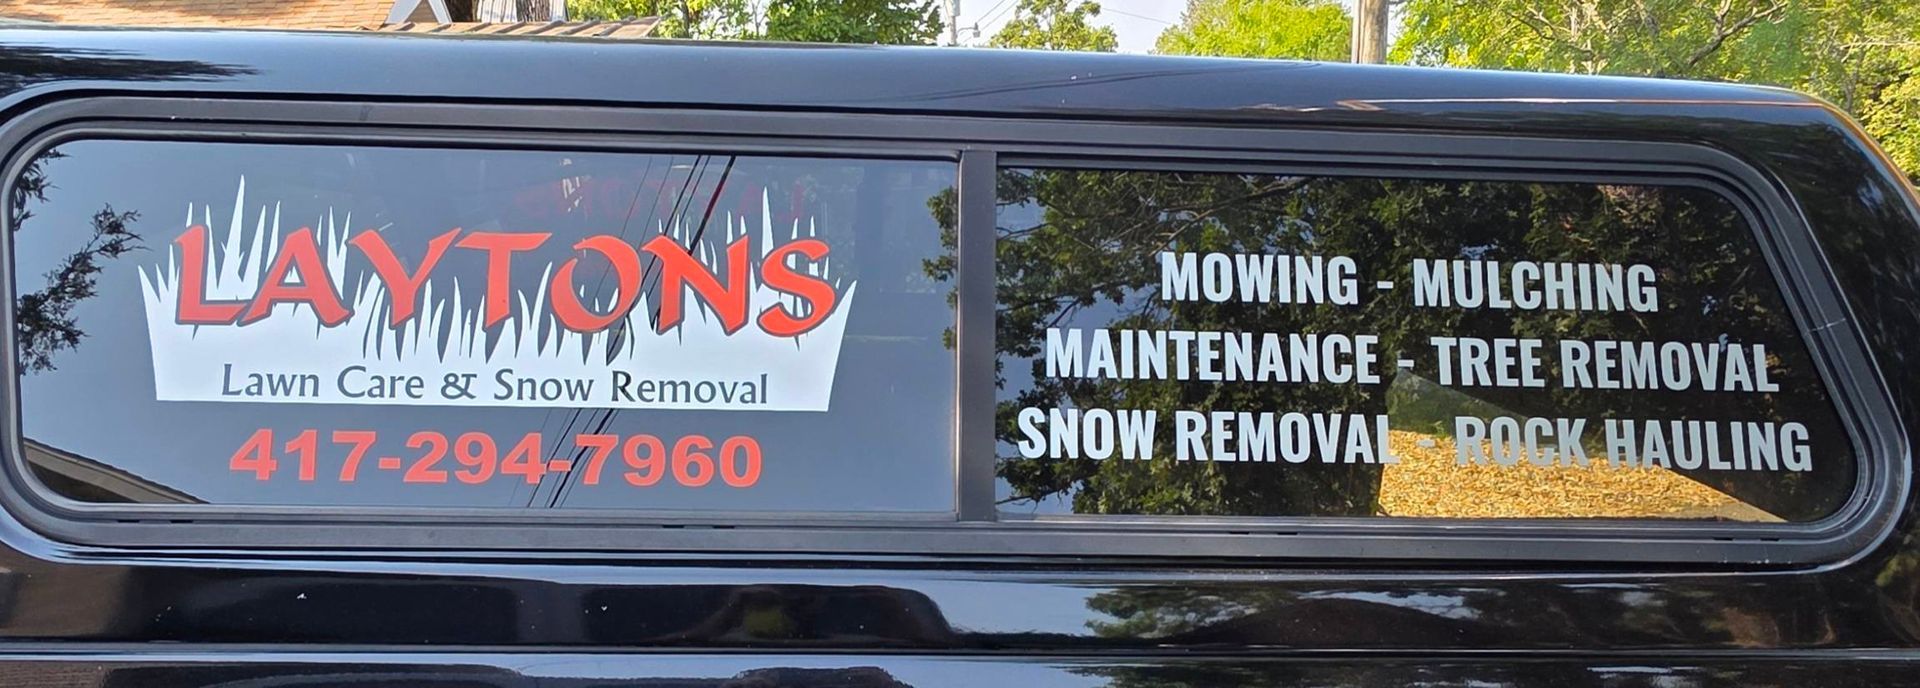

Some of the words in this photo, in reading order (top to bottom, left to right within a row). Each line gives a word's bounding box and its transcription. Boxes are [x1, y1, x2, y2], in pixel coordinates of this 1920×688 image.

[175, 223, 840, 337] LAYTONS
[1160, 252, 1359, 306] MOWING
[1376, 281, 1394, 289] -
[1413, 258, 1659, 312] MULCHING
[221, 363, 320, 399] Lawn
[337, 365, 425, 400] Care
[440, 371, 478, 400] &
[494, 368, 593, 402] Snow
[611, 370, 769, 405] Removal
[1045, 327, 1381, 384] MAINTENANCE
[1398, 359, 1415, 367] -
[1431, 336, 1546, 388] TREE
[1561, 340, 1780, 392] REMOVAL
[230, 428, 762, 488] 417-294-7960
[1017, 408, 1157, 461] SNOW
[1175, 411, 1401, 465] REMOVAL
[1419, 438, 1437, 446] -
[1455, 416, 1590, 468] ROCK
[1604, 420, 1813, 472] HAULING
